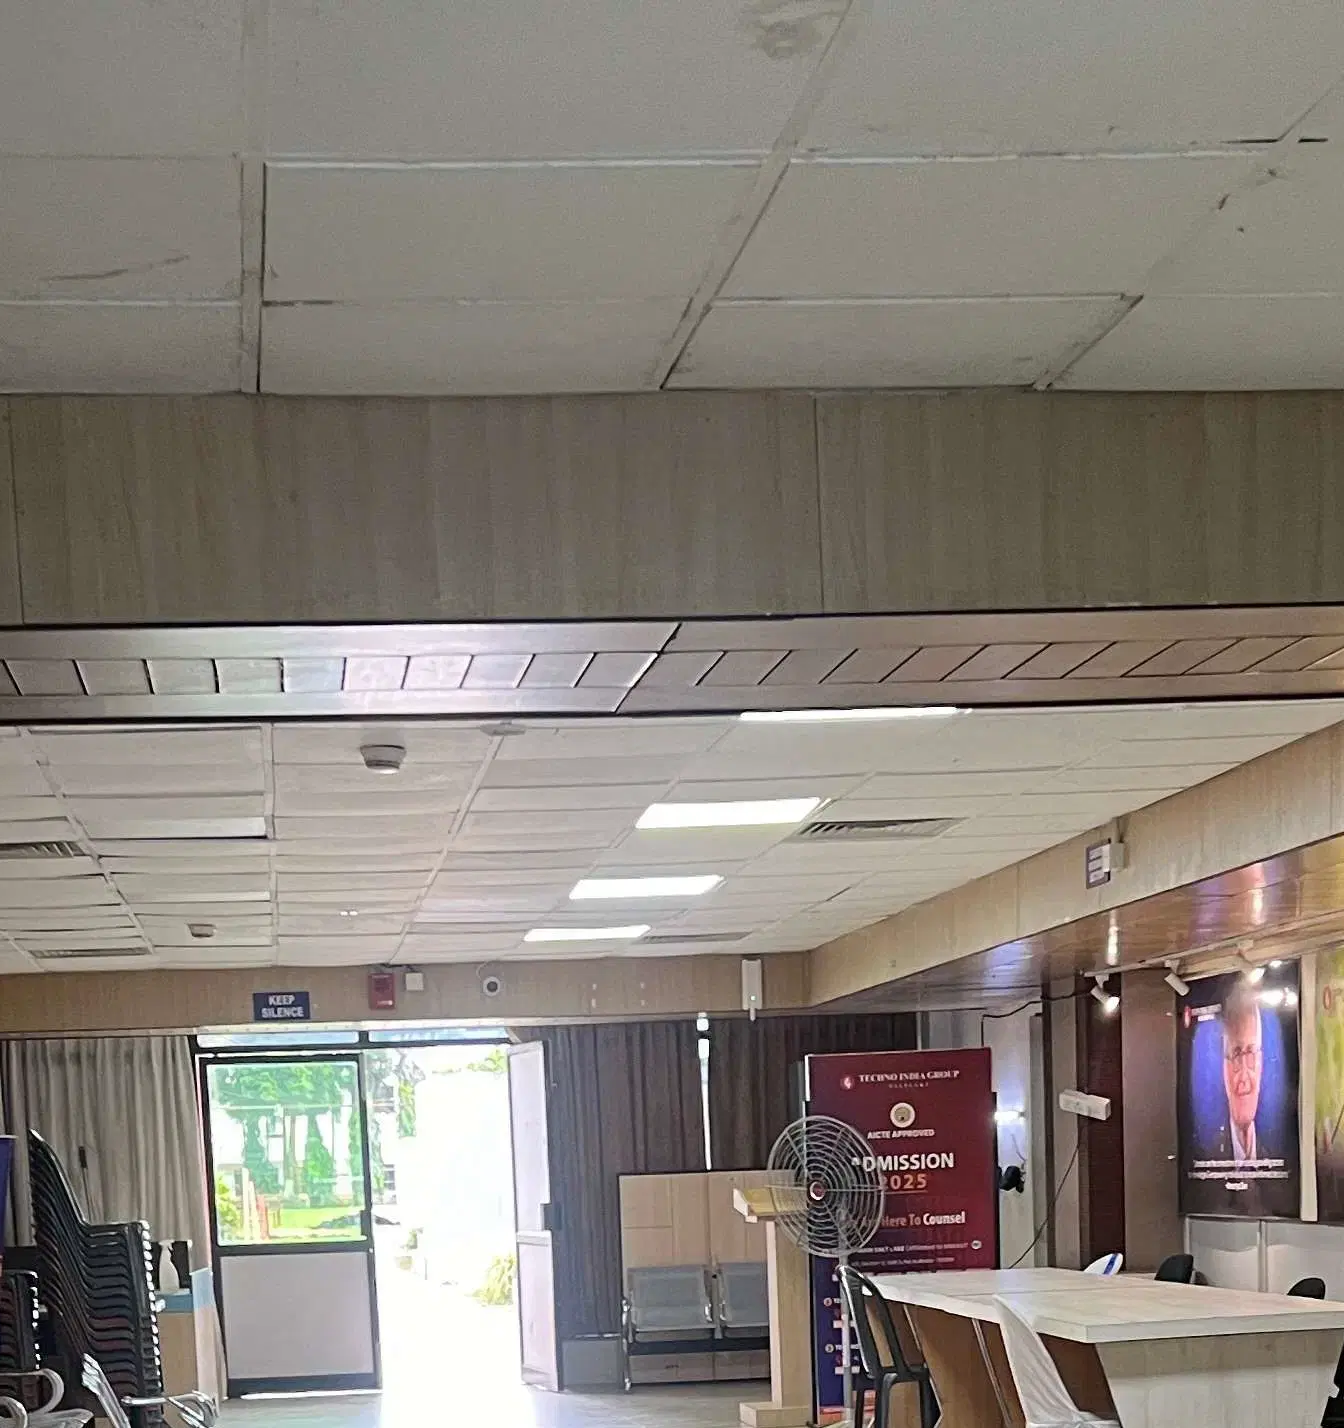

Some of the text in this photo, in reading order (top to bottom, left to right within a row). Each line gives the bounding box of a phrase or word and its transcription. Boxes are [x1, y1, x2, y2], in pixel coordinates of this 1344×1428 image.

[268, 995, 296, 1005] KEEP
[261, 1006, 304, 1018] SILENCE
[858, 1070, 960, 1083] TECHNO INDIA GROUP
[867, 1129, 935, 1140] AICTE APPROVED
[908, 1213, 921, 1226] To
[922, 1211, 966, 1225] Counsel
